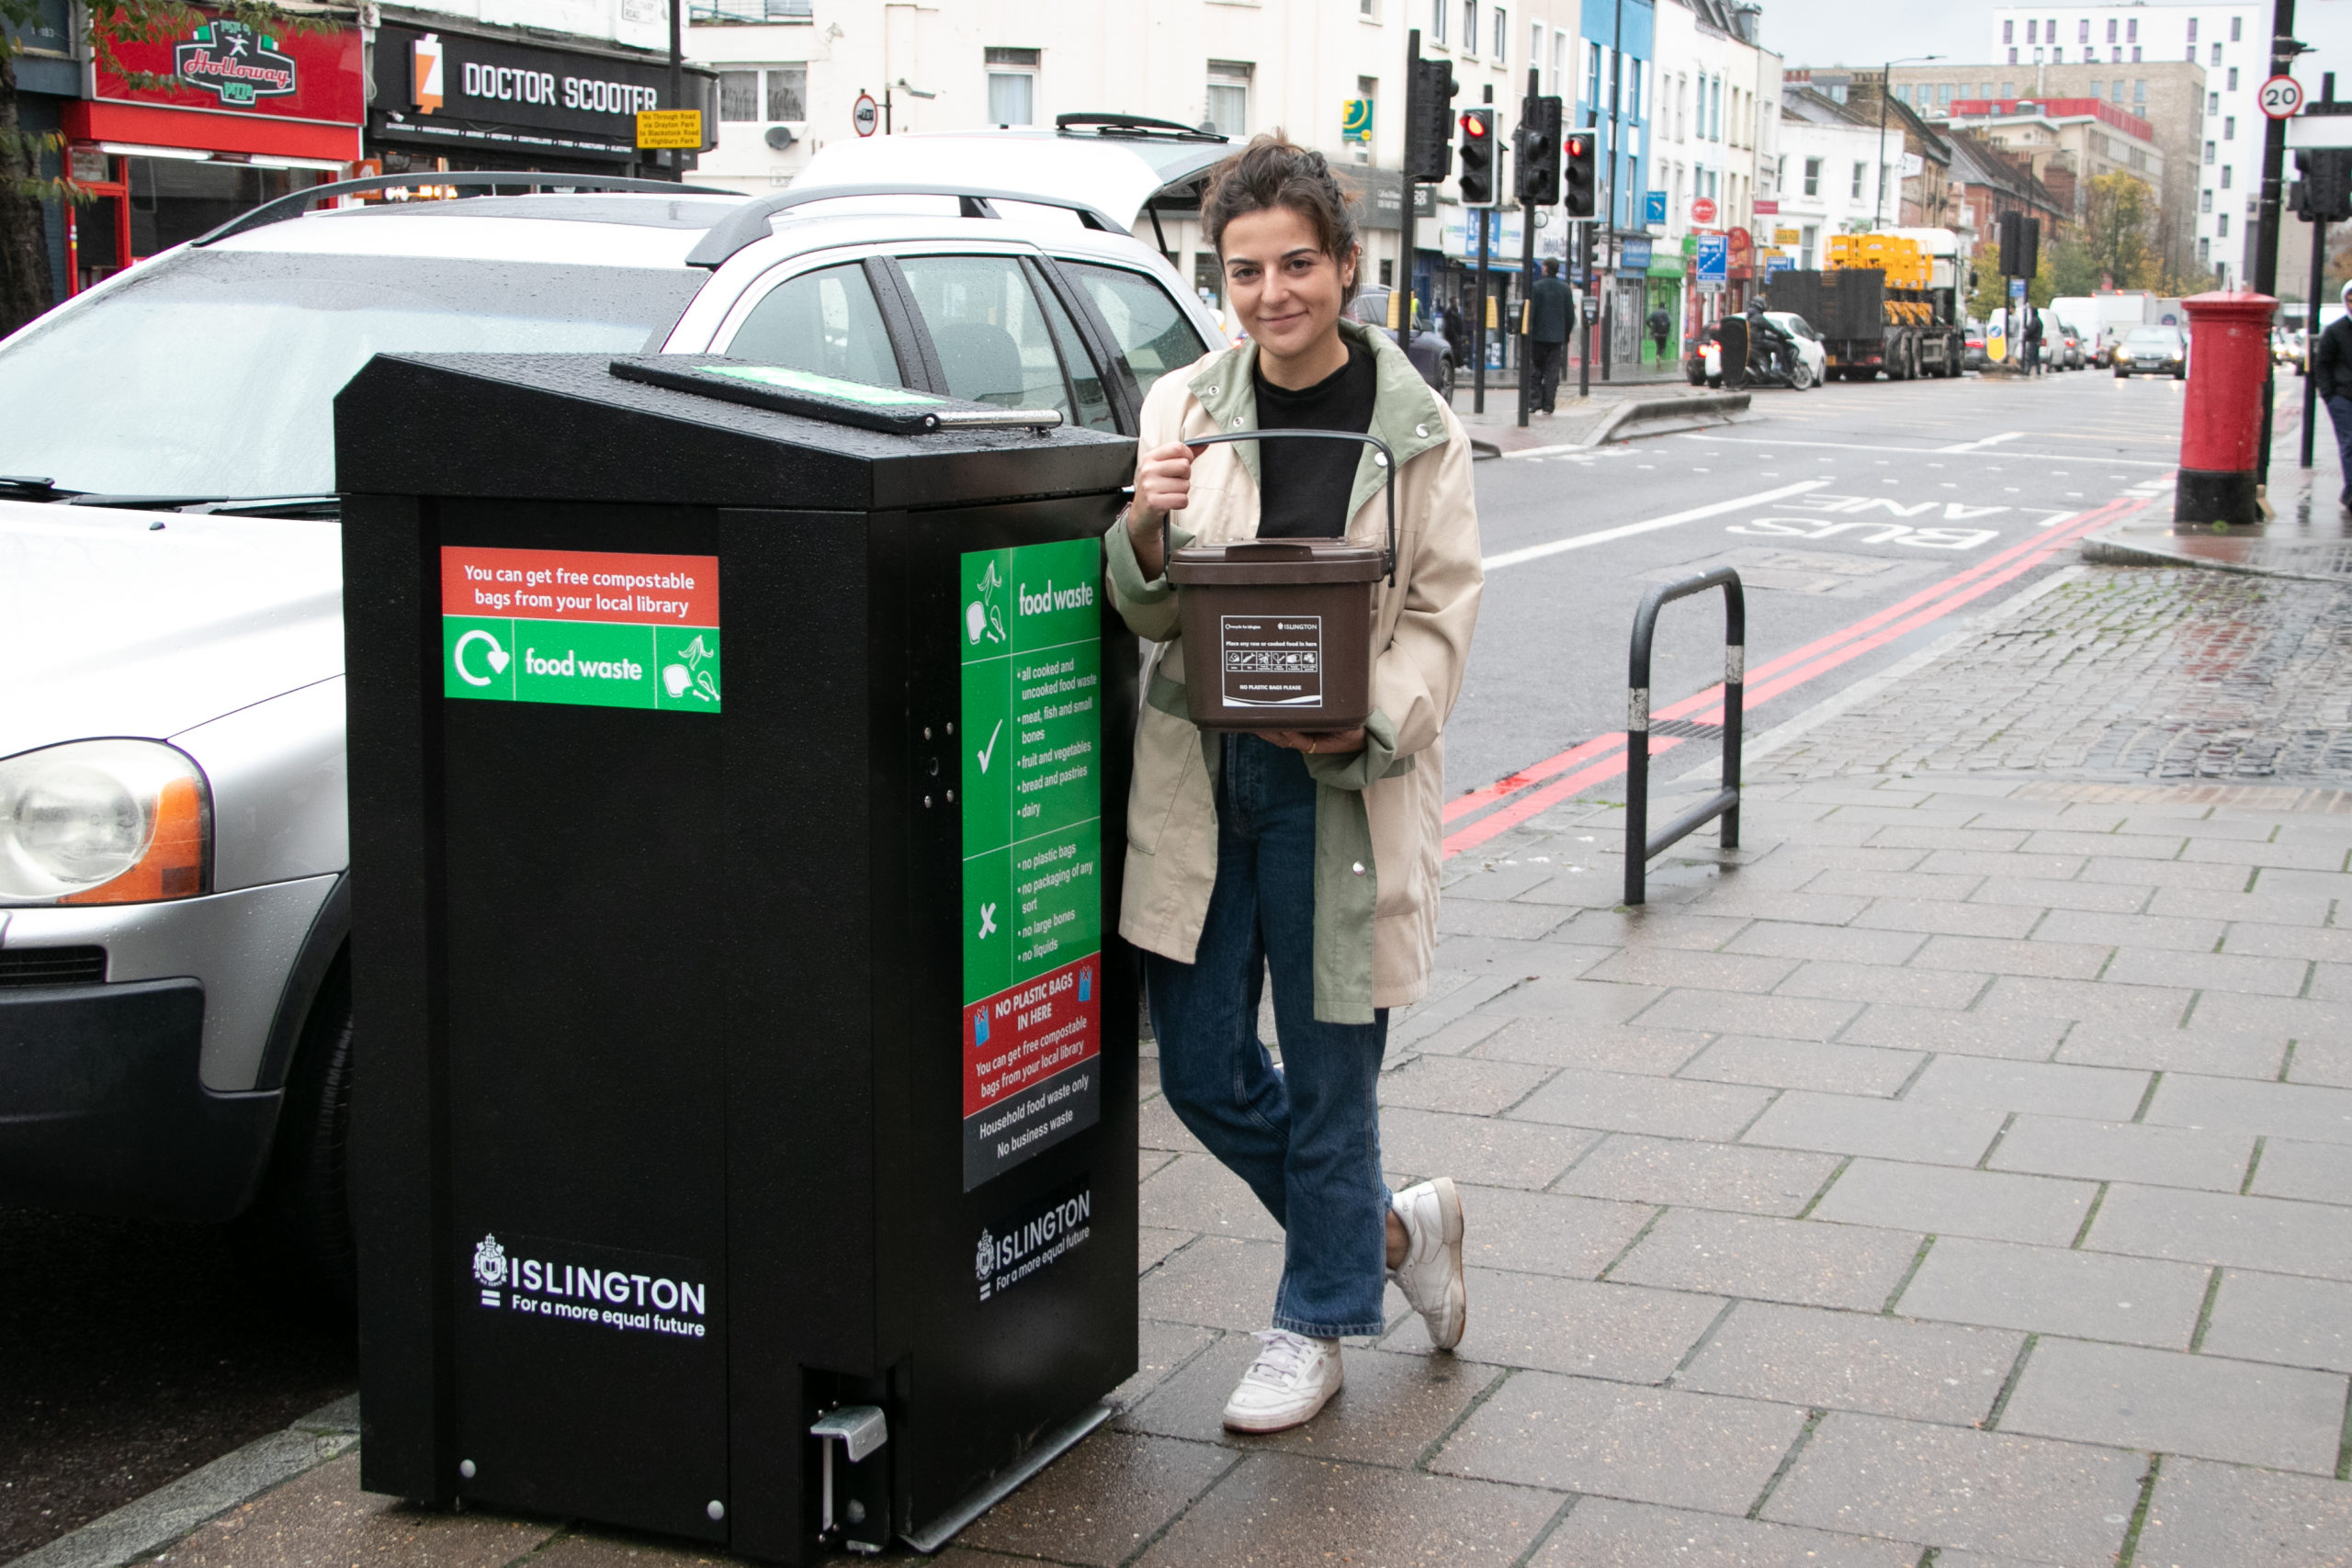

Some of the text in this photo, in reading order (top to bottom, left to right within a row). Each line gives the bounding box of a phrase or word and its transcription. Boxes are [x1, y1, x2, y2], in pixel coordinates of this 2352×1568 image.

[184, 48, 290, 88] Holloway
[463, 62, 657, 116] DOCTOR SCOOTER
[2267, 87, 2296, 106] 20
[1772, 492, 2079, 526] LANE
[1725, 517, 1999, 550] BUS
[465, 565, 695, 591] You can get free compostable
[475, 589, 689, 617] bags from your local library
[1020, 579, 1093, 616] food waste
[526, 648, 642, 680] food waste
[1022, 658, 1074, 681] all cooked and
[1022, 674, 1097, 700] uncooked food waste
[1022, 696, 1092, 725] meat, fish and small
[1022, 729, 1045, 744] bones
[1022, 740, 1091, 769] fruit and vegetables
[1022, 765, 1087, 794] bread and pastries
[1022, 802, 1040, 818] dairy
[1022, 843, 1076, 871] no plastic bags
[1022, 862, 1093, 895] no packaging of any
[1022, 897, 1036, 914] sort
[1023, 909, 1075, 938] no large bones
[1023, 939, 1058, 963] no liquids
[995, 972, 1073, 1019] NO PLASTIC BAGS
[1018, 1003, 1052, 1031] IN HERE
[977, 1015, 1087, 1077] You can get free compostable
[981, 1040, 1084, 1098] bags from your local library
[980, 1074, 1090, 1139] Household food waste only
[997, 1110, 1073, 1159] No business waste
[996, 1190, 1090, 1269] ISLINGTON
[997, 1226, 1090, 1292] For a more equal future
[512, 1258, 705, 1314] ISLINGTON
[512, 1294, 705, 1337] For a more equal future
